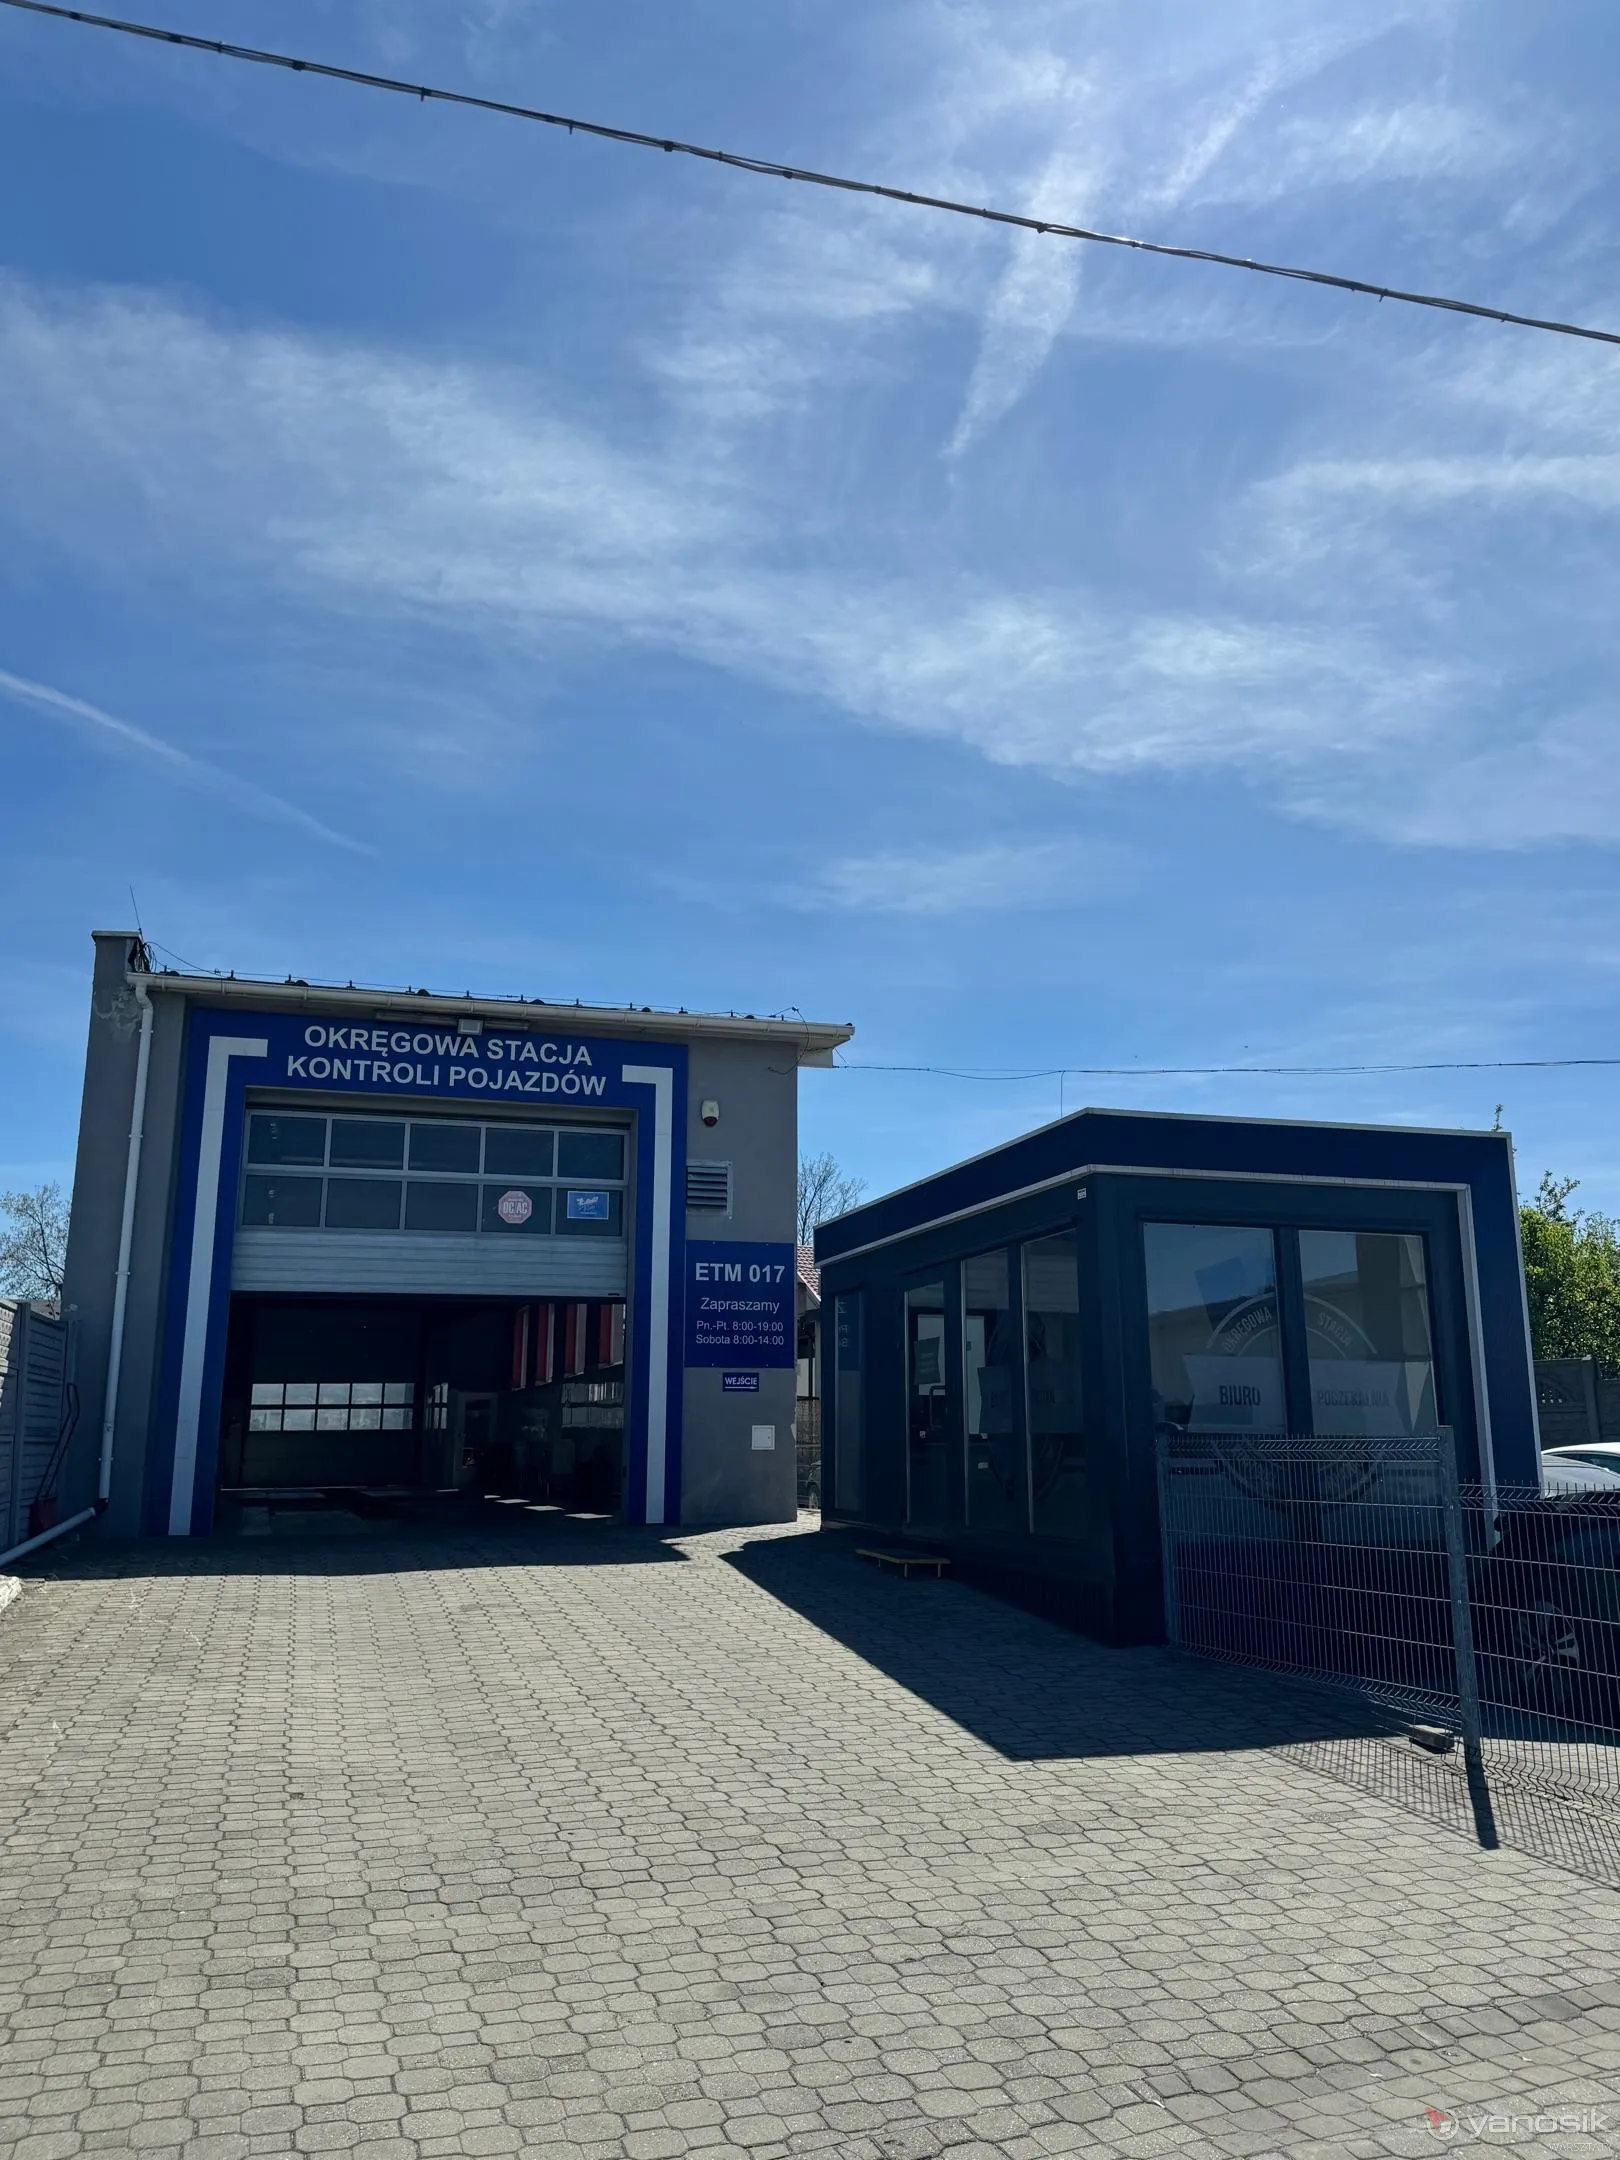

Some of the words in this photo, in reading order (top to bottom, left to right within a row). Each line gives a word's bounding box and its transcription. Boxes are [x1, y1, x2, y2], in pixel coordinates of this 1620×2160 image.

[304, 1025, 480, 1058] OKRĘGOWA
[486, 1037, 593, 1067] STACJA
[287, 1055, 440, 1086] KONTROLI
[449, 1066, 607, 1096] POJAZDÓW
[695, 1262, 742, 1282] ETM
[749, 1264, 785, 1283] 017
[700, 1297, 780, 1314] Zapraszamy
[696, 1320, 730, 1331] Pn.-Pt.
[732, 1321, 784, 1332] 8:00-19:00
[1221, 1306, 1273, 1353] OKRĘGOWA
[695, 1334, 731, 1345] Sobota
[733, 1335, 785, 1346] 8:00-14:00
[724, 1375, 758, 1386] WEJŚCIE
[1219, 1385, 1261, 1407] BIURO
